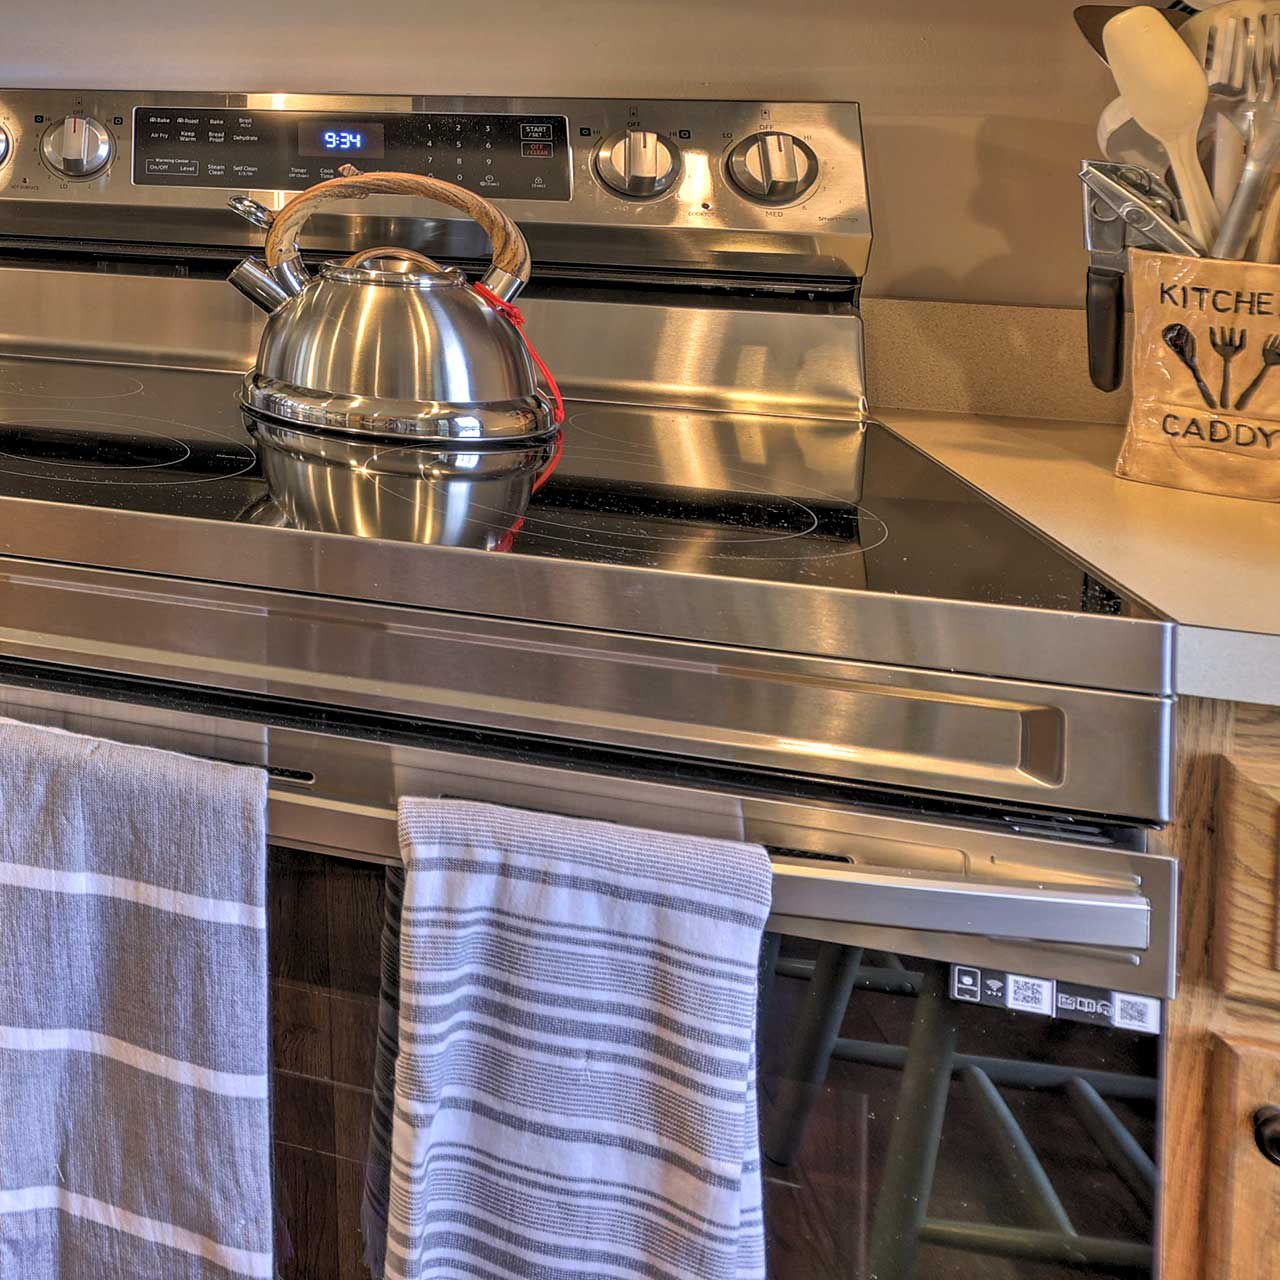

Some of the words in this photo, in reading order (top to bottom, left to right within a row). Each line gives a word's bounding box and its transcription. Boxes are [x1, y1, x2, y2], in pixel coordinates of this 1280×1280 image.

[427, 123, 432, 131] 1
[159, 132, 168, 140] Fry
[324, 132, 361, 148] 9:34
[1160, 281, 1280, 317] KITCHE
[1162, 413, 1280, 448] CADDY
